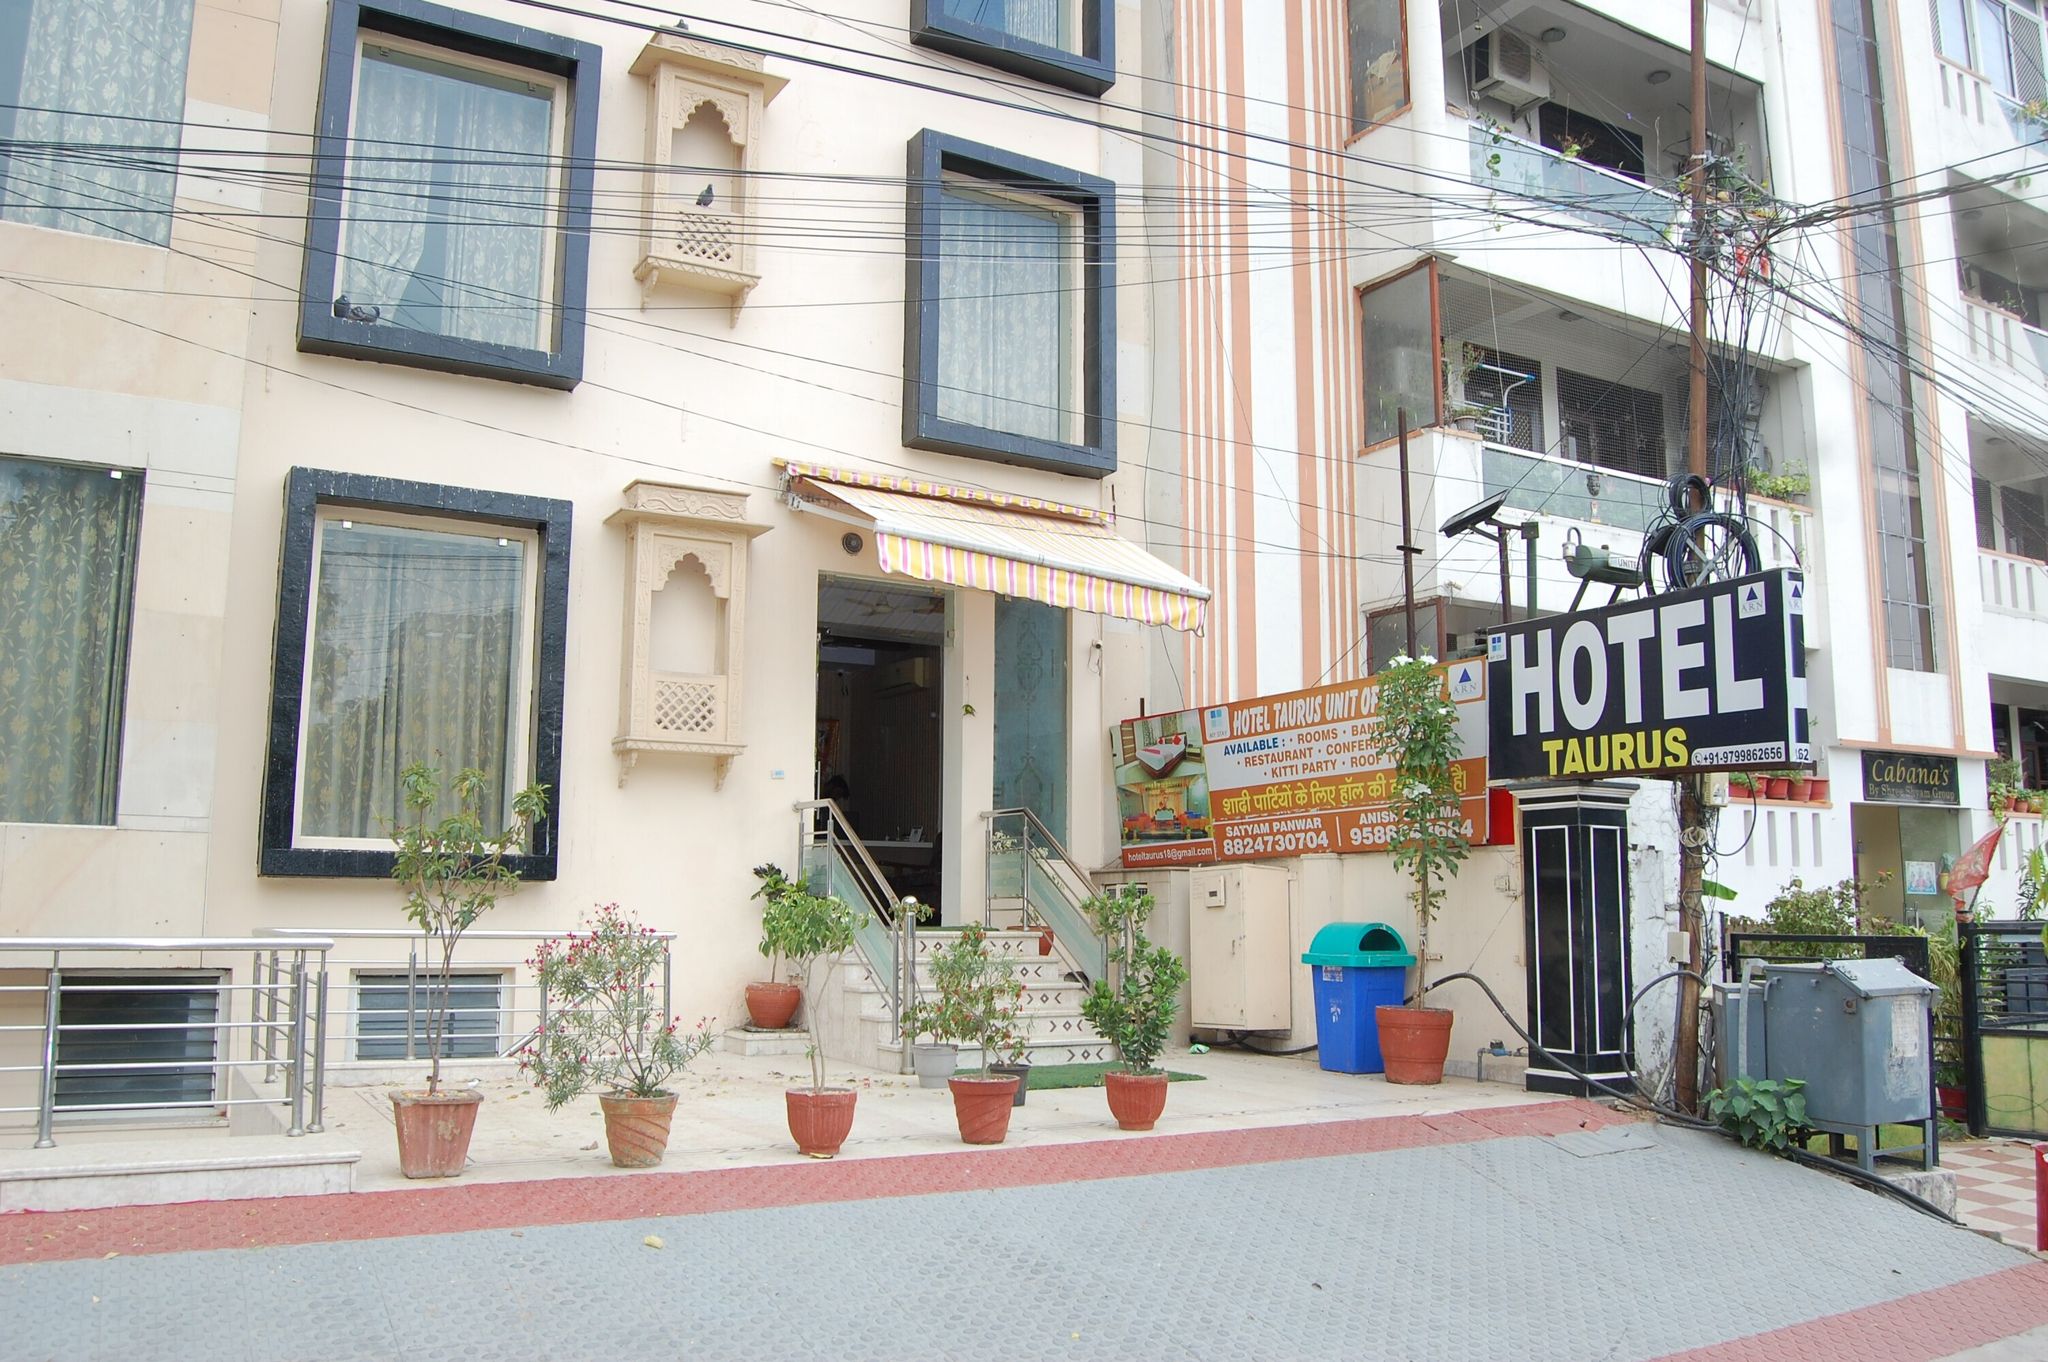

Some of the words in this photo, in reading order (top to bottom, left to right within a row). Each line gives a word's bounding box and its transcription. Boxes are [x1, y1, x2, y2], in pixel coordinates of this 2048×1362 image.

[1741, 601, 1763, 612] ARN
[1511, 594, 1764, 736] HOTEL
[1453, 683, 1477, 695] ARN
[1233, 705, 1270, 736] HOTEL
[1273, 695, 1323, 729] TAURUS
[1325, 689, 1358, 721] UNIT
[1360, 685, 1379, 715] OF
[1224, 737, 1279, 756] AVAILABLE
[1297, 728, 1338, 745] ROOMS
[1244, 747, 1314, 767] RESTAURANT
[1326, 737, 1399, 756] CONFERENC
[1542, 727, 1689, 775] TAURUS
[1271, 764, 1299, 778] KITTI
[1302, 759, 1337, 774] PARTY
[1350, 753, 1382, 768] ROOF
[1386, 751, 1402, 764] TO
[1703, 747, 1783, 765] +91-9799862656
[1872, 758, 1949, 786] Cabana's
[1222, 790, 1251, 815] शादी
[1253, 784, 1293, 811] पार्टियों
[1294, 782, 1308, 806] के
[1310, 781, 1336, 806] लिए
[1338, 776, 1364, 806] हॉल
[1367, 773, 1386, 798] की
[1869, 783, 1879, 797] By
[1881, 783, 1904, 798] Shree
[1904, 785, 1931, 799] Shyam
[1932, 787, 1955, 800] Group
[1225, 822, 1270, 837] SATYAM
[1272, 817, 1322, 833] PANWAR
[1128, 847, 1213, 862] hoteltaurus18@gmail.com
[1223, 831, 1329, 855] 8824730704
